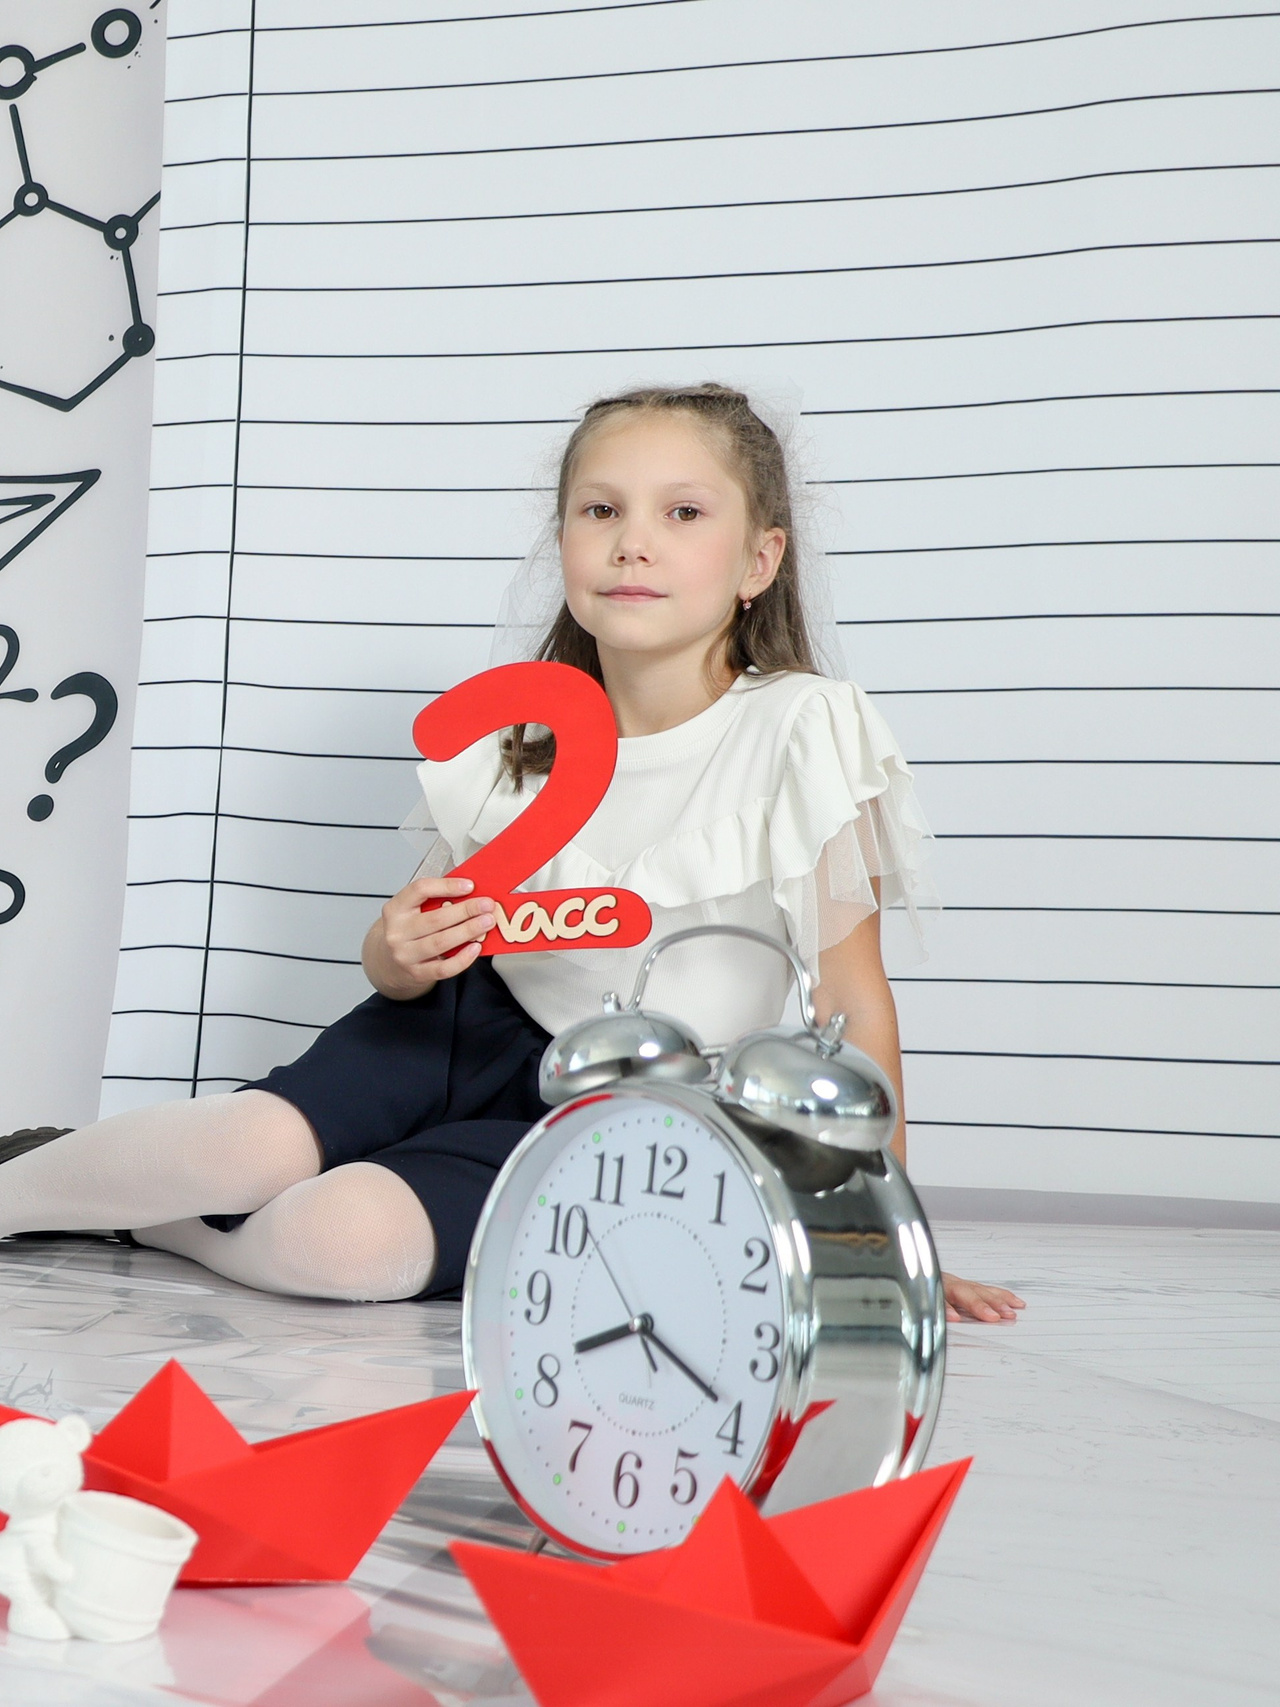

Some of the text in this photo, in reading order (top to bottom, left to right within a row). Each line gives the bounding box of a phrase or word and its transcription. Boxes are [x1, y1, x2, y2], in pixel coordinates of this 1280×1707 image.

[412, 660, 652, 957] 2
[590, 1152, 625, 1207] 11
[641, 1142, 688, 1200] 12
[709, 1171, 727, 1226] 1
[545, 1202, 589, 1259] 10
[740, 1237, 770, 1294] 2
[525, 1269, 552, 1325] 9
[533, 1353, 560, 1408] 8
[749, 1322, 780, 1382] 3
[618, 1391, 655, 1411] QUARTZ
[716, 1401, 744, 1458] 4
[568, 1419, 593, 1473] 7
[613, 1451, 642, 1508] 6
[670, 1448, 700, 1505] 5
